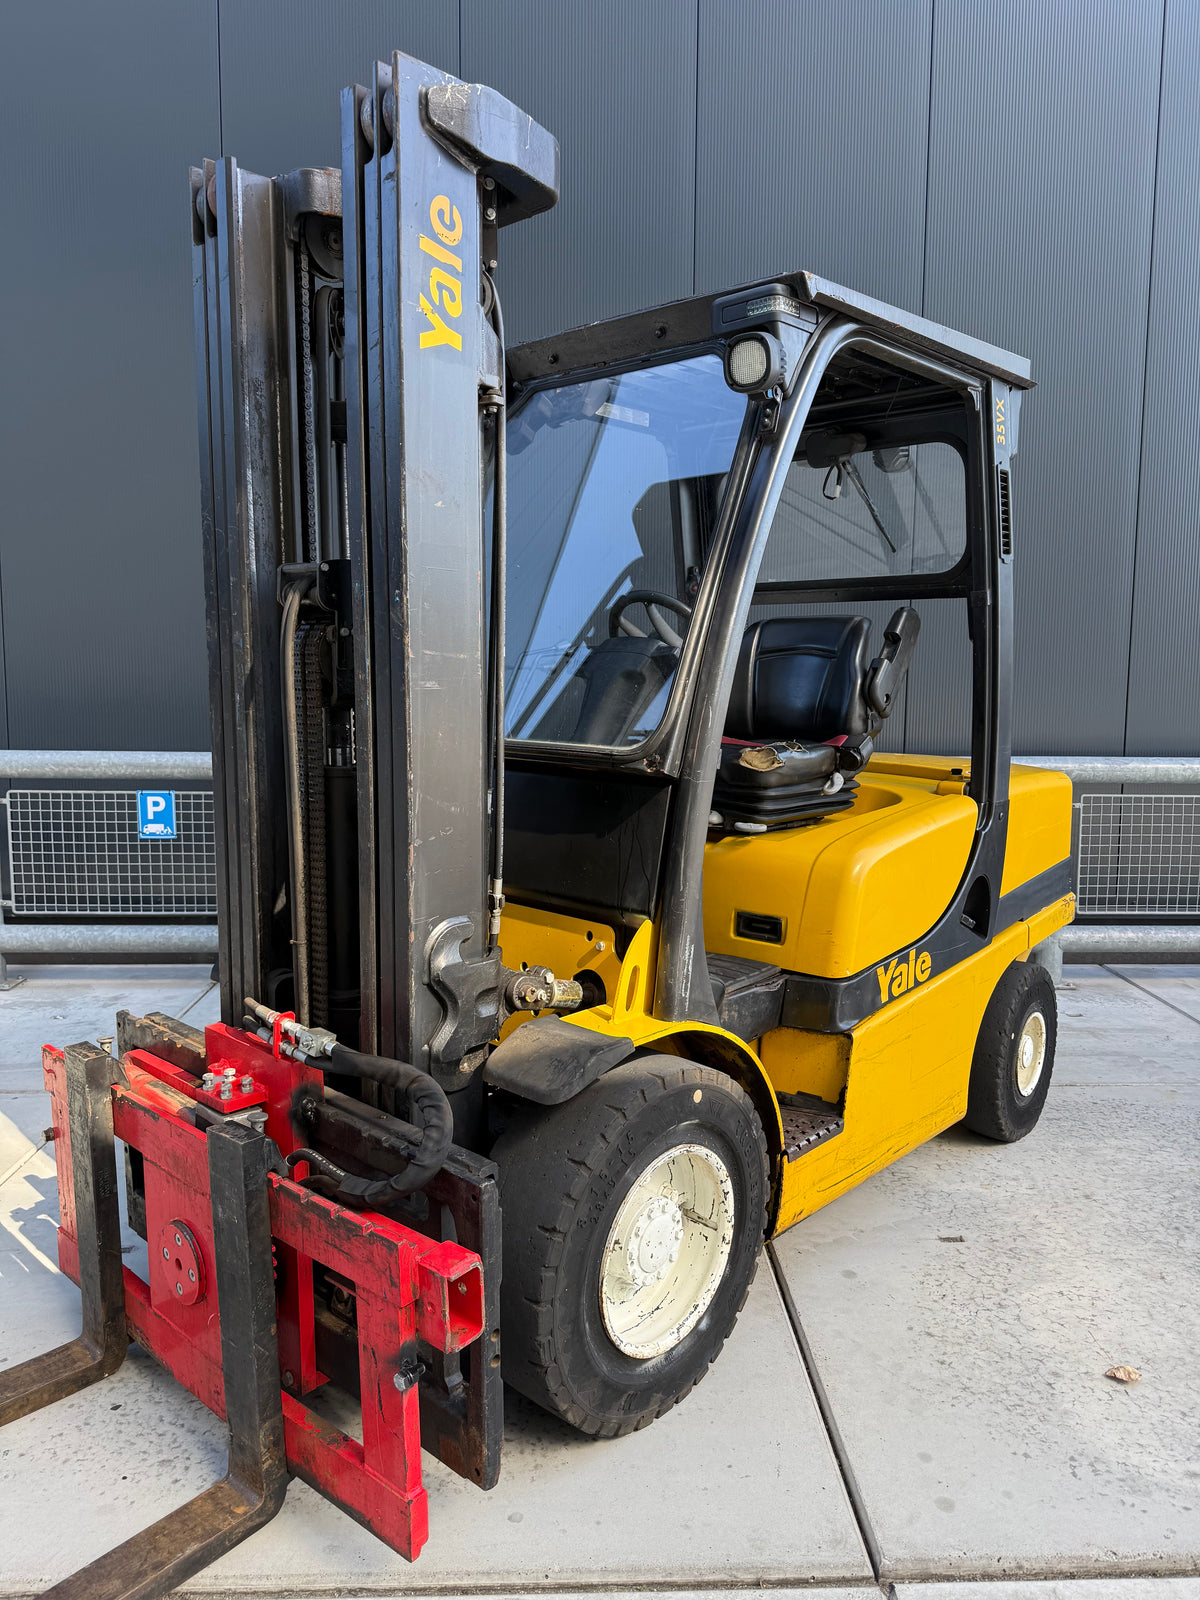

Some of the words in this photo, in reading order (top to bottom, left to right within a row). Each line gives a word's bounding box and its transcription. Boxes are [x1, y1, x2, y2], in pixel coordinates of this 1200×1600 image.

[419, 194, 463, 352] Yale
[995, 397, 1006, 446] 35VX
[146, 795, 166, 820] P
[876, 948, 932, 1004] Yale
